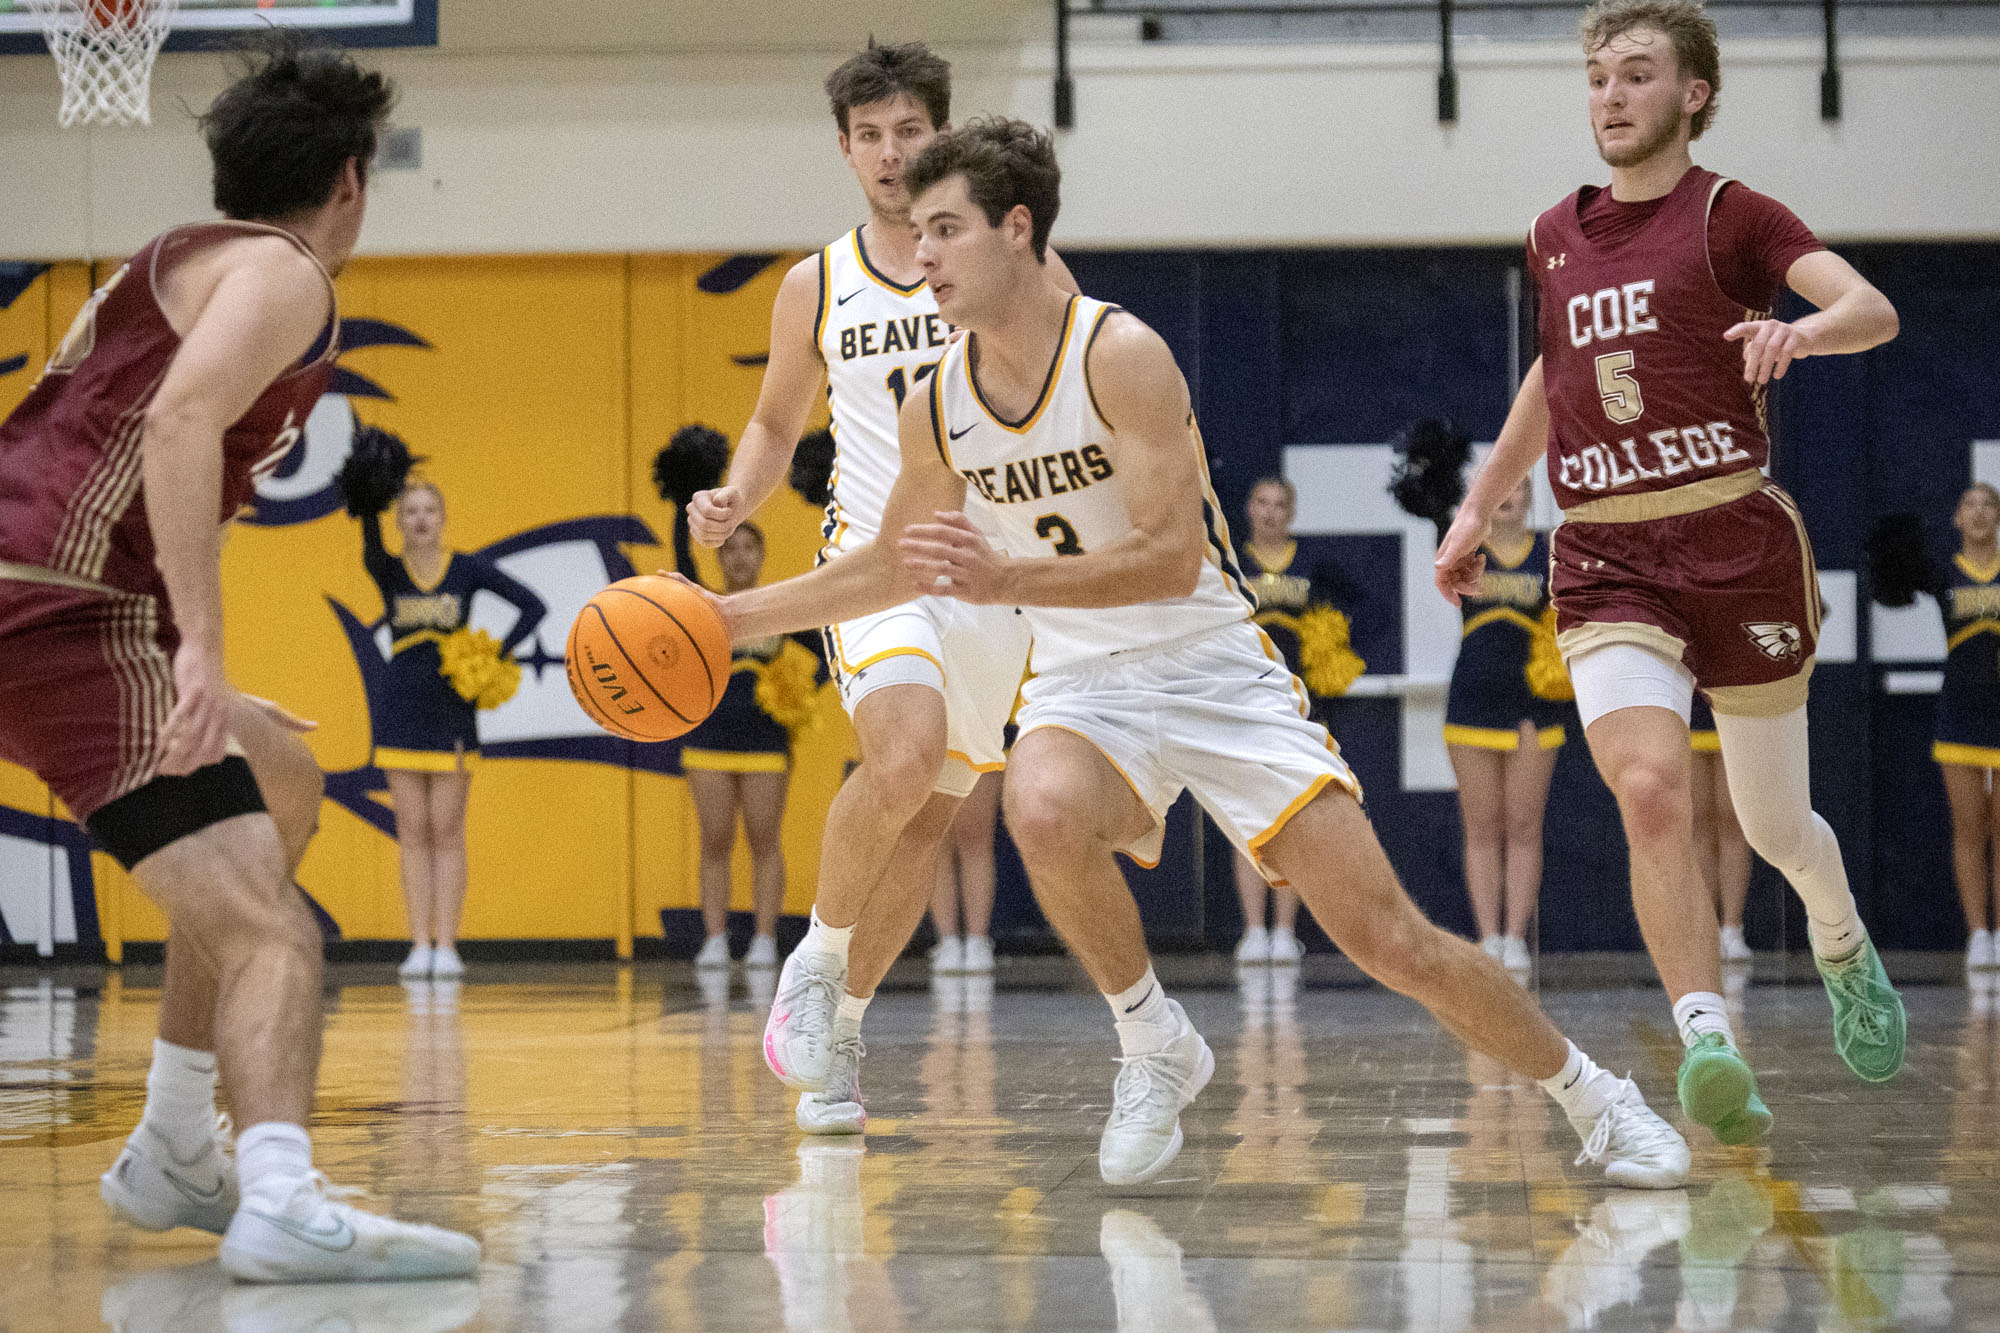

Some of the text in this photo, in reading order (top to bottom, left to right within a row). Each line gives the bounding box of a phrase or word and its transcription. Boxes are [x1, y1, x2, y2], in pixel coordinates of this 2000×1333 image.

[841, 312, 956, 361] BEAVE
[1567, 279, 1659, 348] COE
[1595, 349, 1645, 425] 5
[1560, 420, 1751, 490] COLLEGE
[592, 663, 645, 715] EVO
